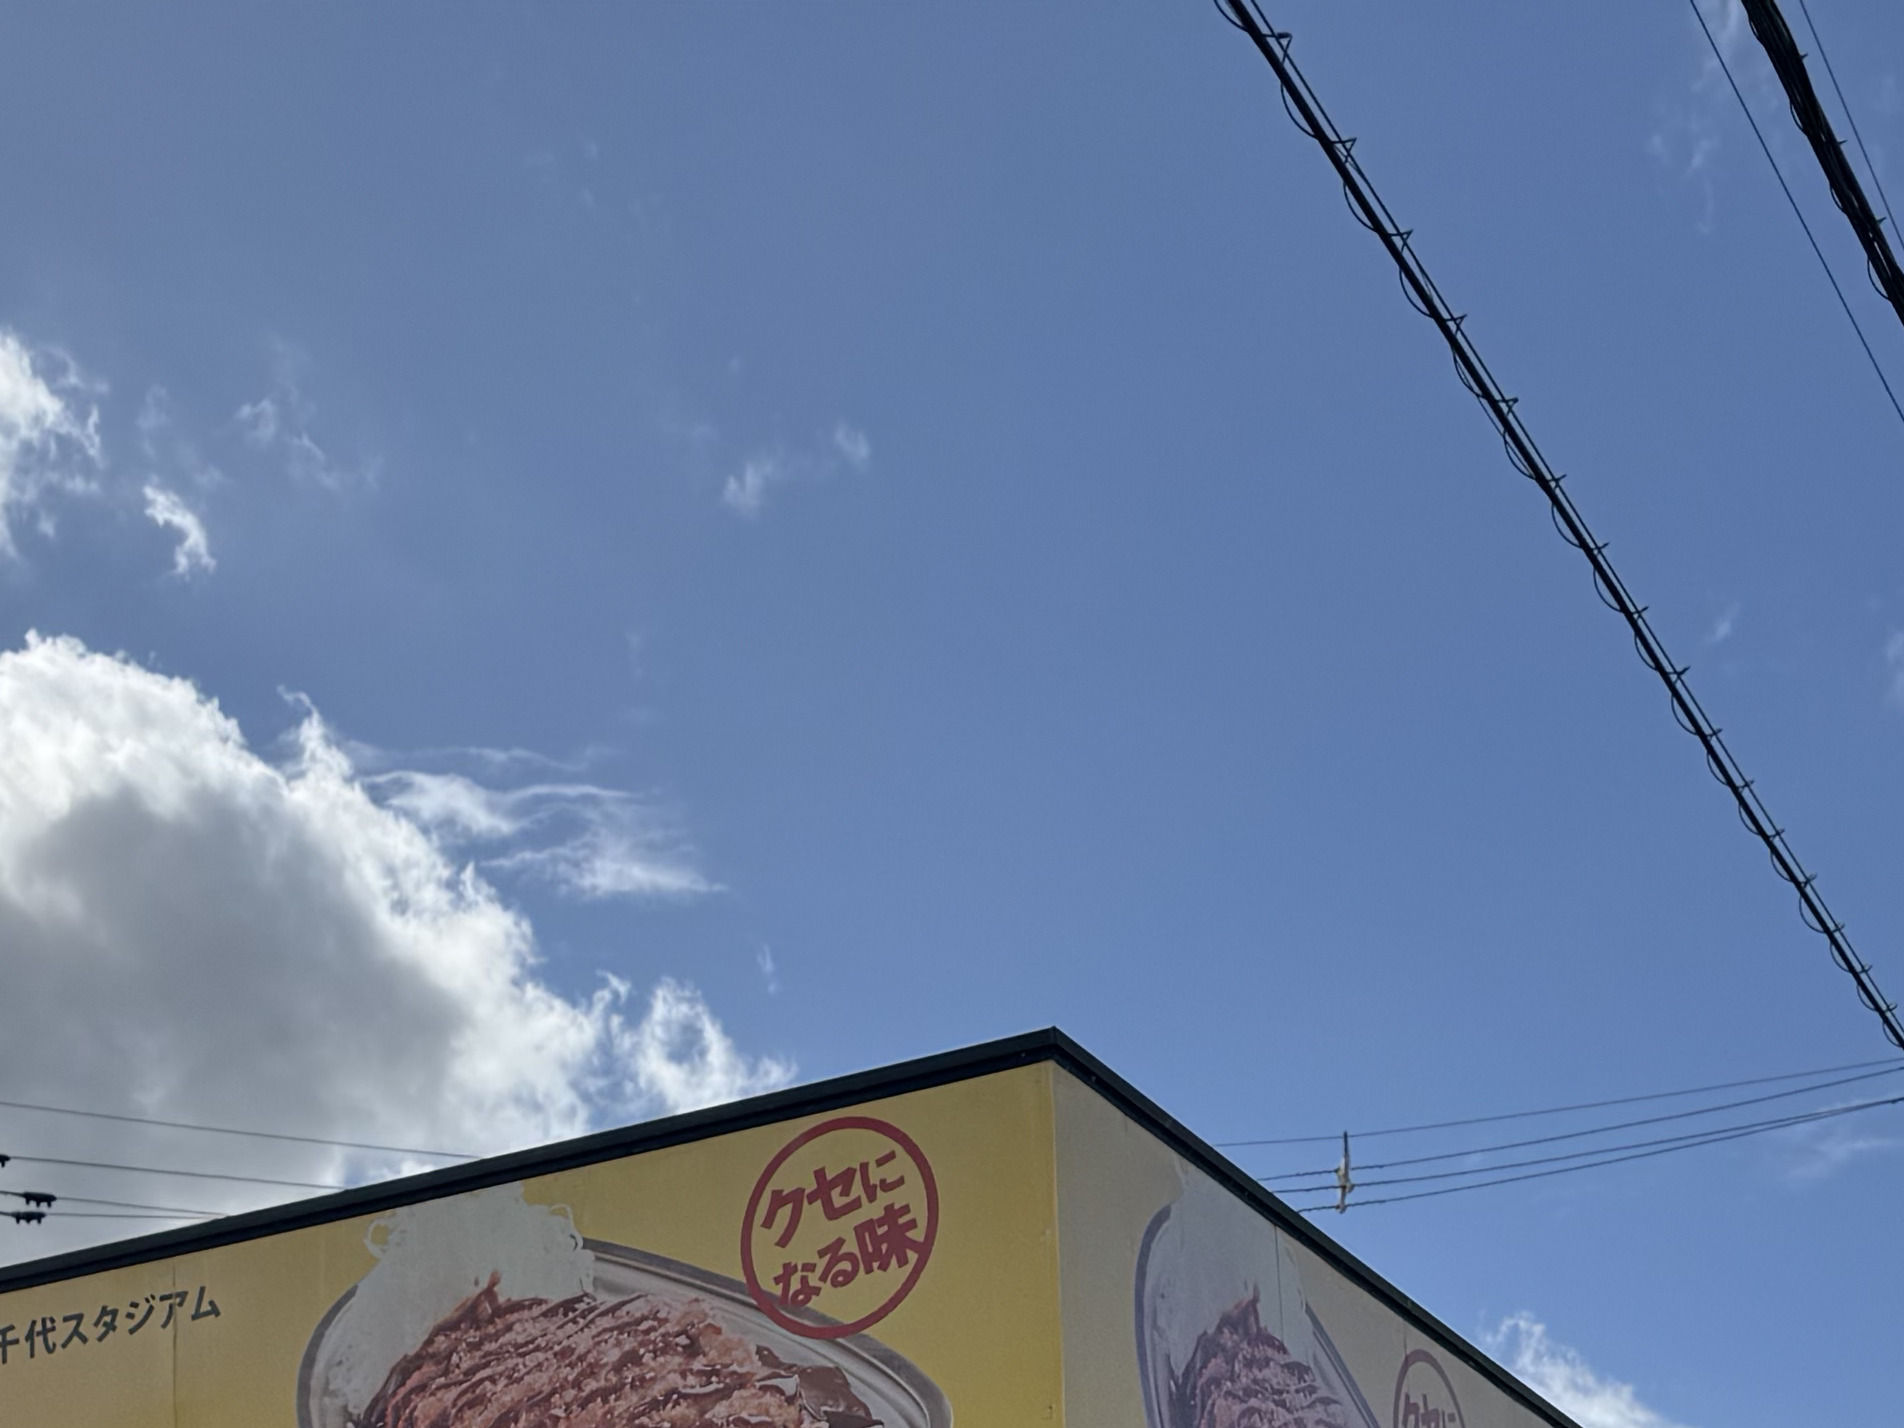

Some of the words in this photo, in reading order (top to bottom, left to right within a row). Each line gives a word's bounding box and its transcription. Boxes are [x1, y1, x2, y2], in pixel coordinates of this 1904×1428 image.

[760, 1150, 905, 1248] クセに
[773, 1203, 926, 1308] なる味
